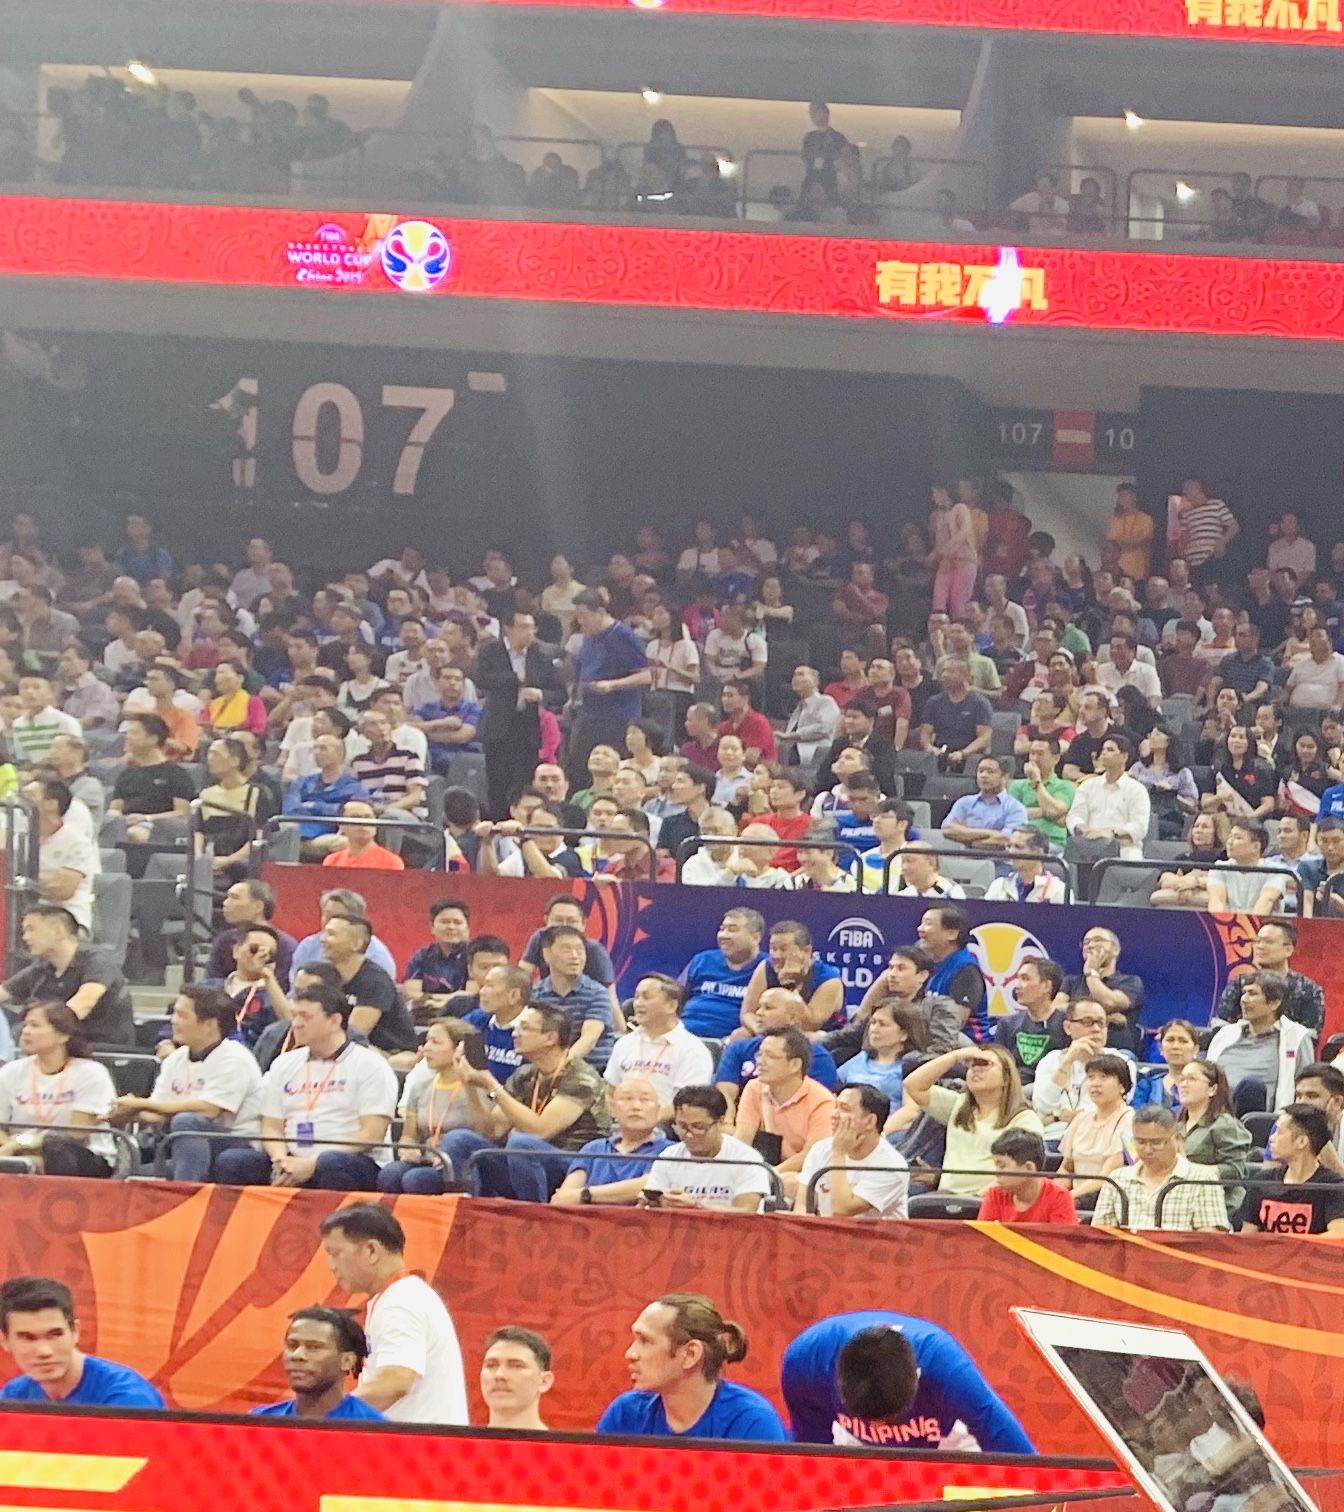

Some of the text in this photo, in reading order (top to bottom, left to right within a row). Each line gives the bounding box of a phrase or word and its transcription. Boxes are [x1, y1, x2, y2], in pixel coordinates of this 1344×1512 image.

[287, 251, 374, 266] WORLD CUP
[209, 378, 454, 494] 107
[999, 423, 1042, 445] 107
[839, 929, 874, 948] FIBA
[1262, 1204, 1308, 1234] Lee
